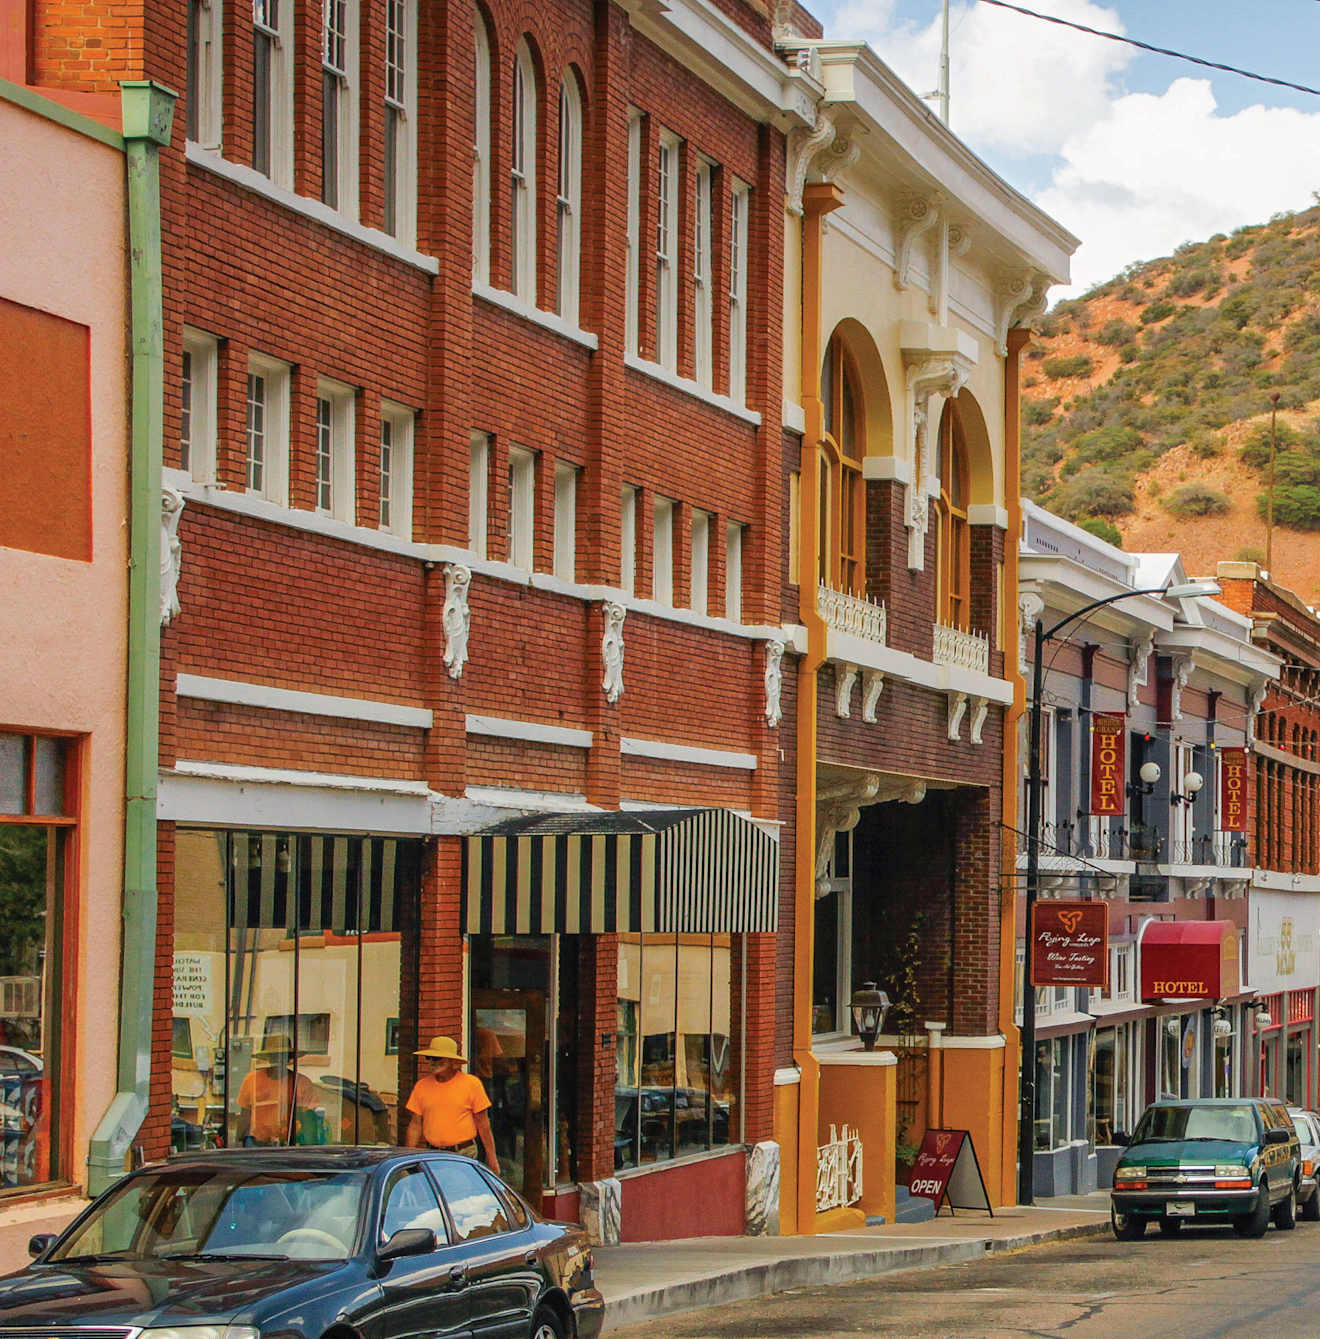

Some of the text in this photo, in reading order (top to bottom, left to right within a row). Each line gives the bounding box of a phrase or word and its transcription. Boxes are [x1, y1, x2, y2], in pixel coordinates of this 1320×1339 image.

[1100, 734, 1116, 810] HOTEL
[1228, 765, 1241, 828] HOTEL
[1153, 981, 1209, 995] HOTEL
[911, 1179, 943, 1195] OPEN
